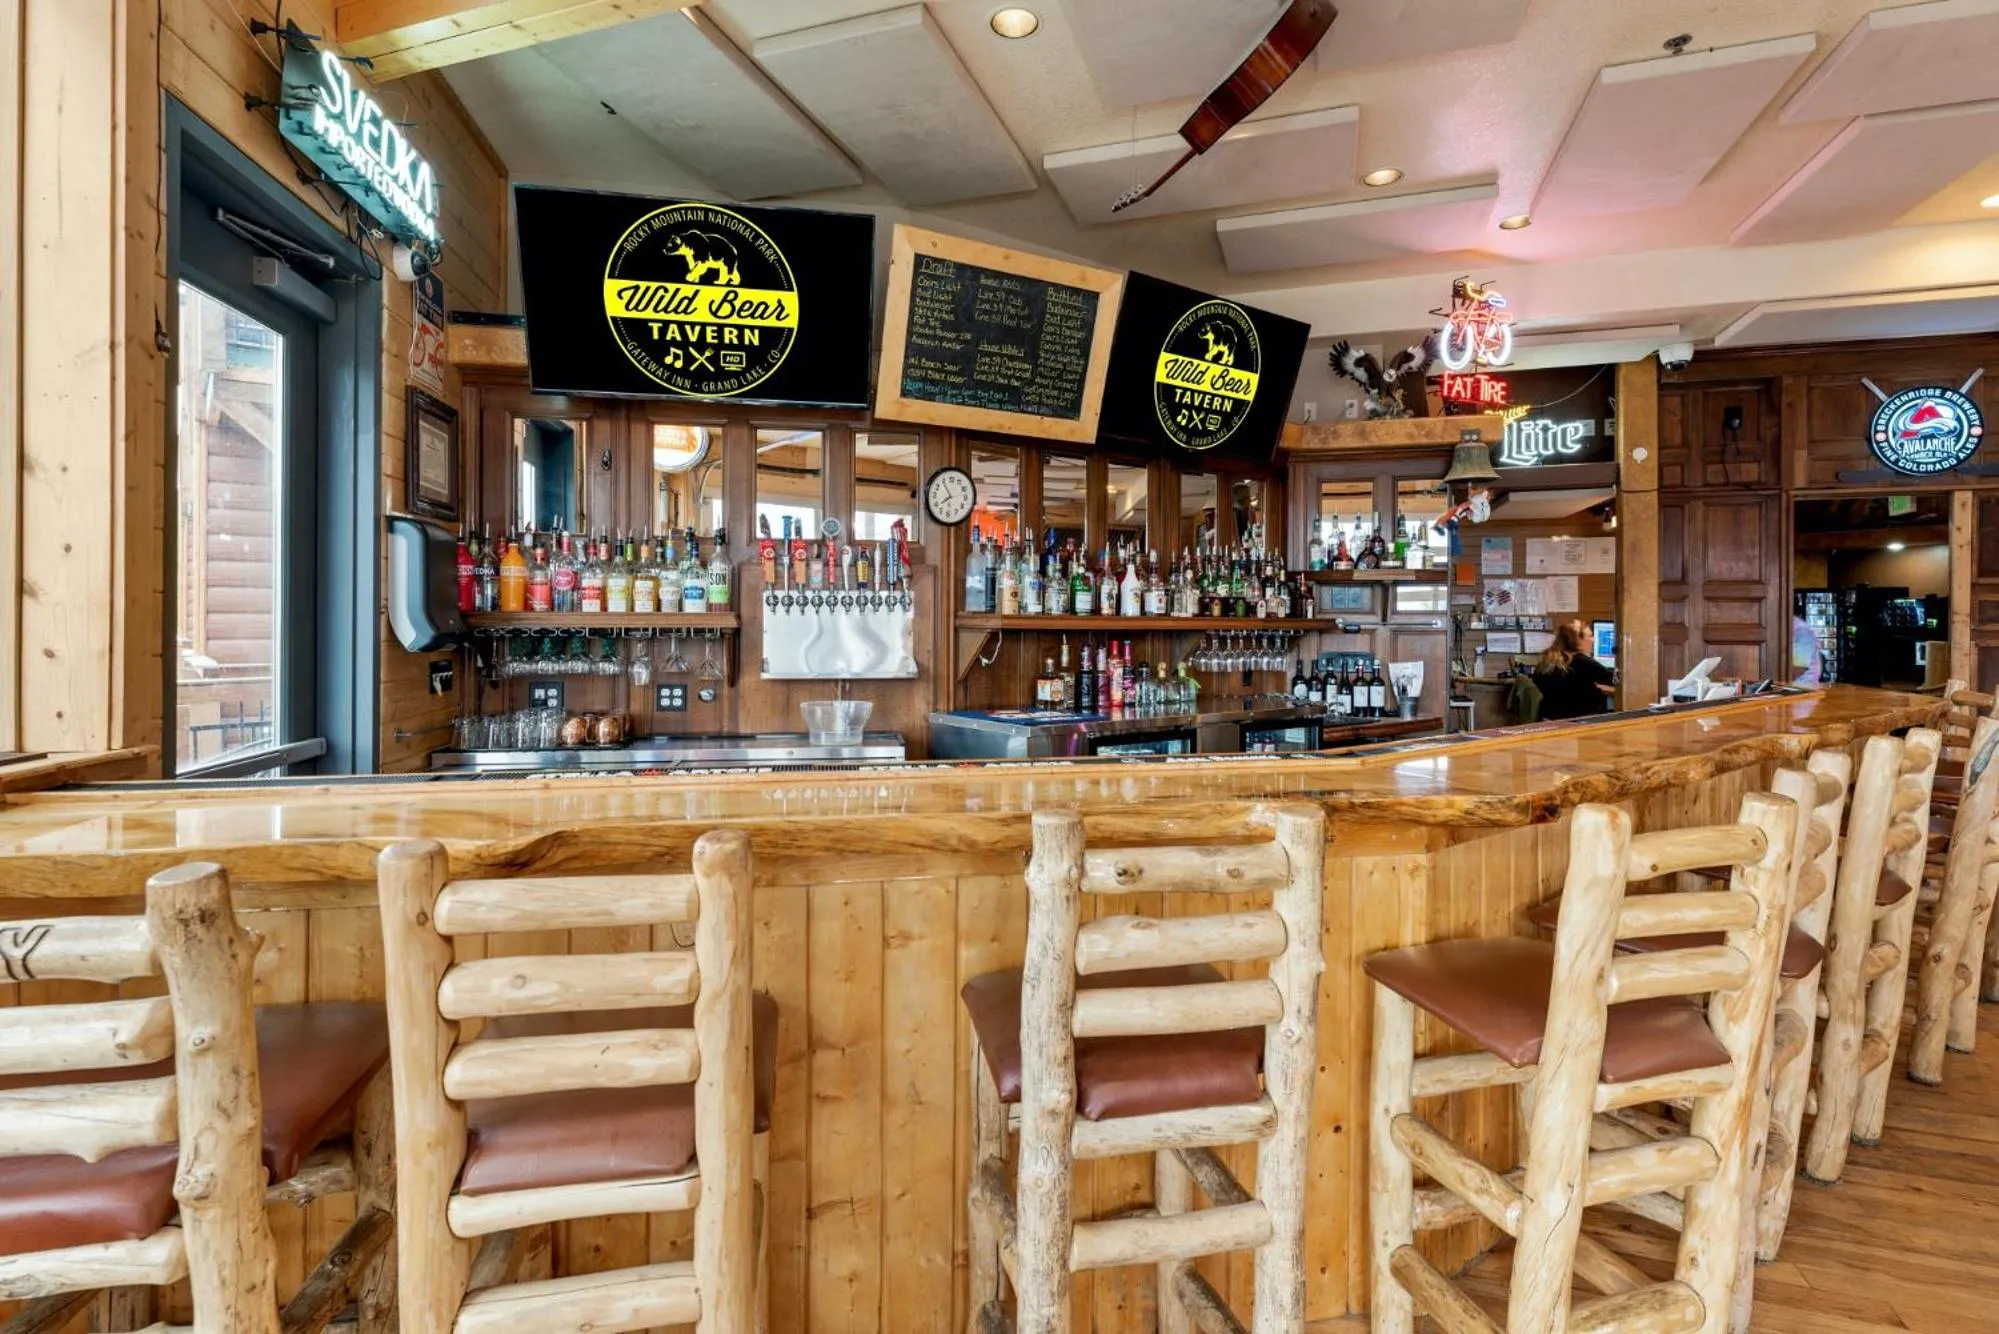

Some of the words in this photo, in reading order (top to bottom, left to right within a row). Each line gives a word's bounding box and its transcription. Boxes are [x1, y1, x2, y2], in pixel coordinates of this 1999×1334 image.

[320, 51, 433, 214] SVEDKA
[623, 224, 649, 253] ROCKY
[650, 209, 705, 231] MOUNTAIN
[708, 210, 755, 241] NATIONAL
[755, 238, 778, 263] PARK
[920, 258, 956, 277] Draft
[617, 285, 700, 315] Wild
[709, 290, 790, 321] Bear
[648, 322, 760, 346] TAVERN
[627, 341, 670, 380] GATEWAY
[672, 375, 691, 389] INN
[702, 379, 739, 392] GRAND
[741, 365, 766, 385] LAKE
[726, 355, 740, 363] HD
[1164, 358, 1209, 386] Wild
[1210, 366, 1252, 395] Bear
[1174, 388, 1234, 412] TAVERN
[1443, 372, 1474, 400] FAT
[1478, 375, 1507, 404] TIRE
[1877, 388, 1942, 431] BRECKENRIDGE
[1944, 390, 1981, 426] BREWERY
[1500, 419, 1583, 466] Lite
[1879, 442, 1899, 462] FINE
[1898, 458, 1957, 472] COLORADO
[1958, 437, 1979, 459] ALES
[1902, 437, 1957, 457] AVALANCHE
